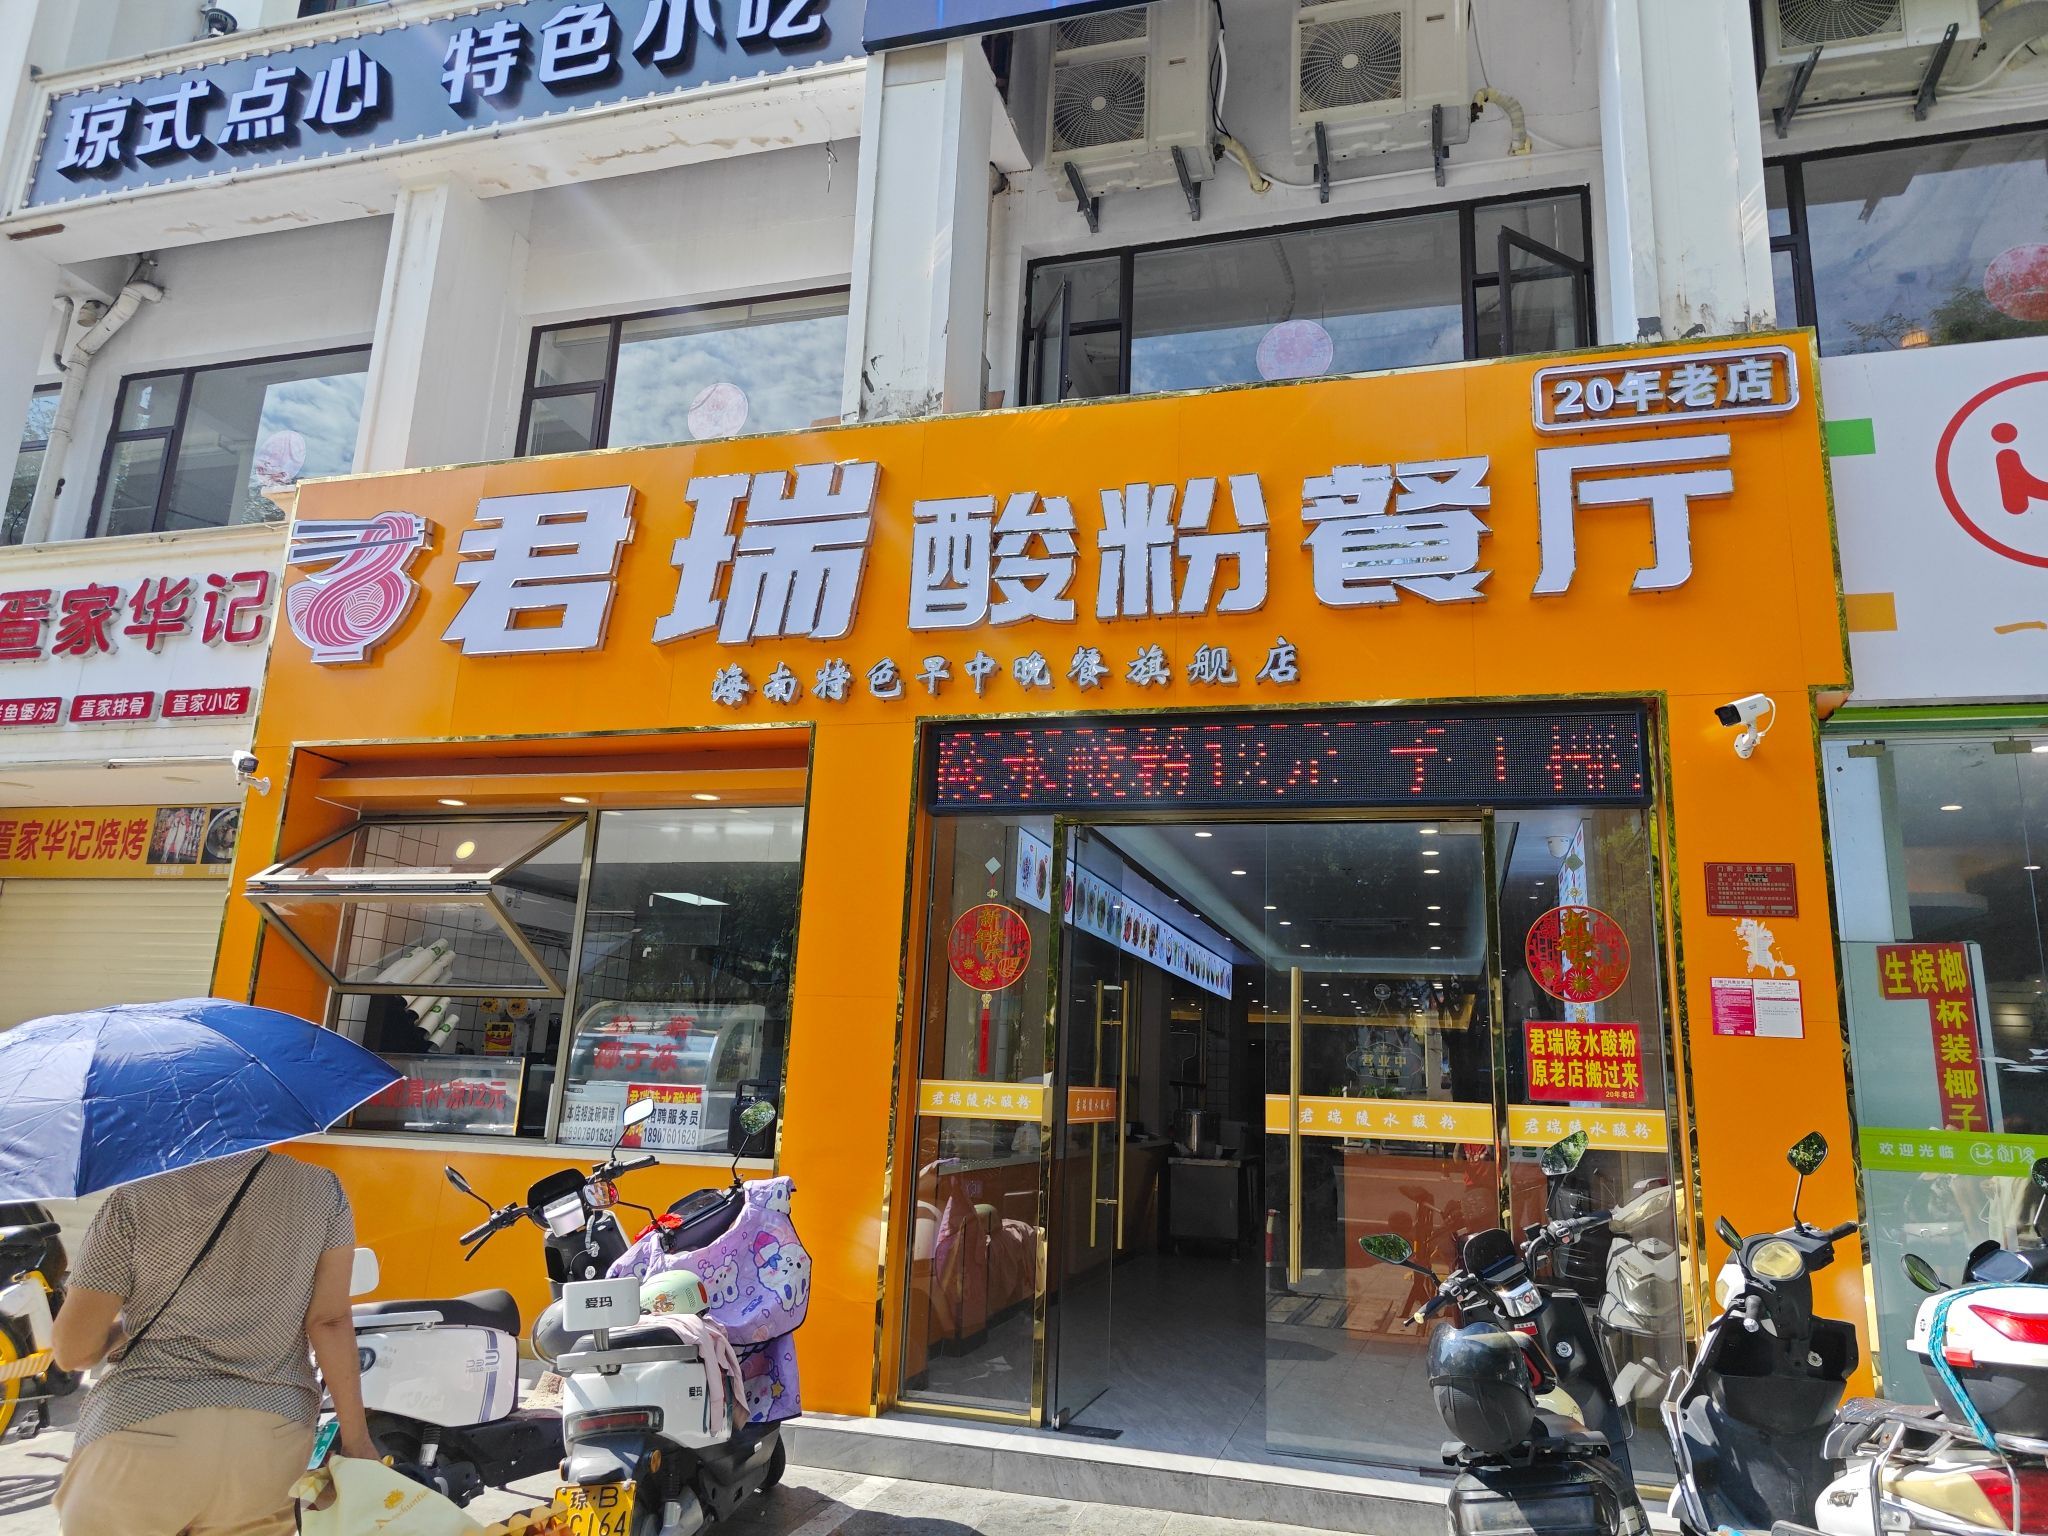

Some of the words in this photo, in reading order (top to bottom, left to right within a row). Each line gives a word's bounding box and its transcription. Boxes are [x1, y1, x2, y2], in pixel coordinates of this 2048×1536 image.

[56, 48, 379, 172] 琼式点心
[1553, 357, 1774, 416] 20年老店
[441, 433, 1735, 657] 君瑞酸粉餐厅
[711, 635, 1302, 704] 海南特色早中晚餐旗舰店
[1884, 948, 1967, 995] 生槟榔
[1529, 1028, 1636, 1058] 君瑞陵水酸粉
[1935, 998, 1981, 1132] 杯装椰子
[1532, 1059, 1639, 1089] 原老店搬过来
[643, 1128, 697, 1145] 18907601629
[1879, 1142, 1954, 1159] 欢迎光临
[585, 1296, 613, 1309] 爱玛
